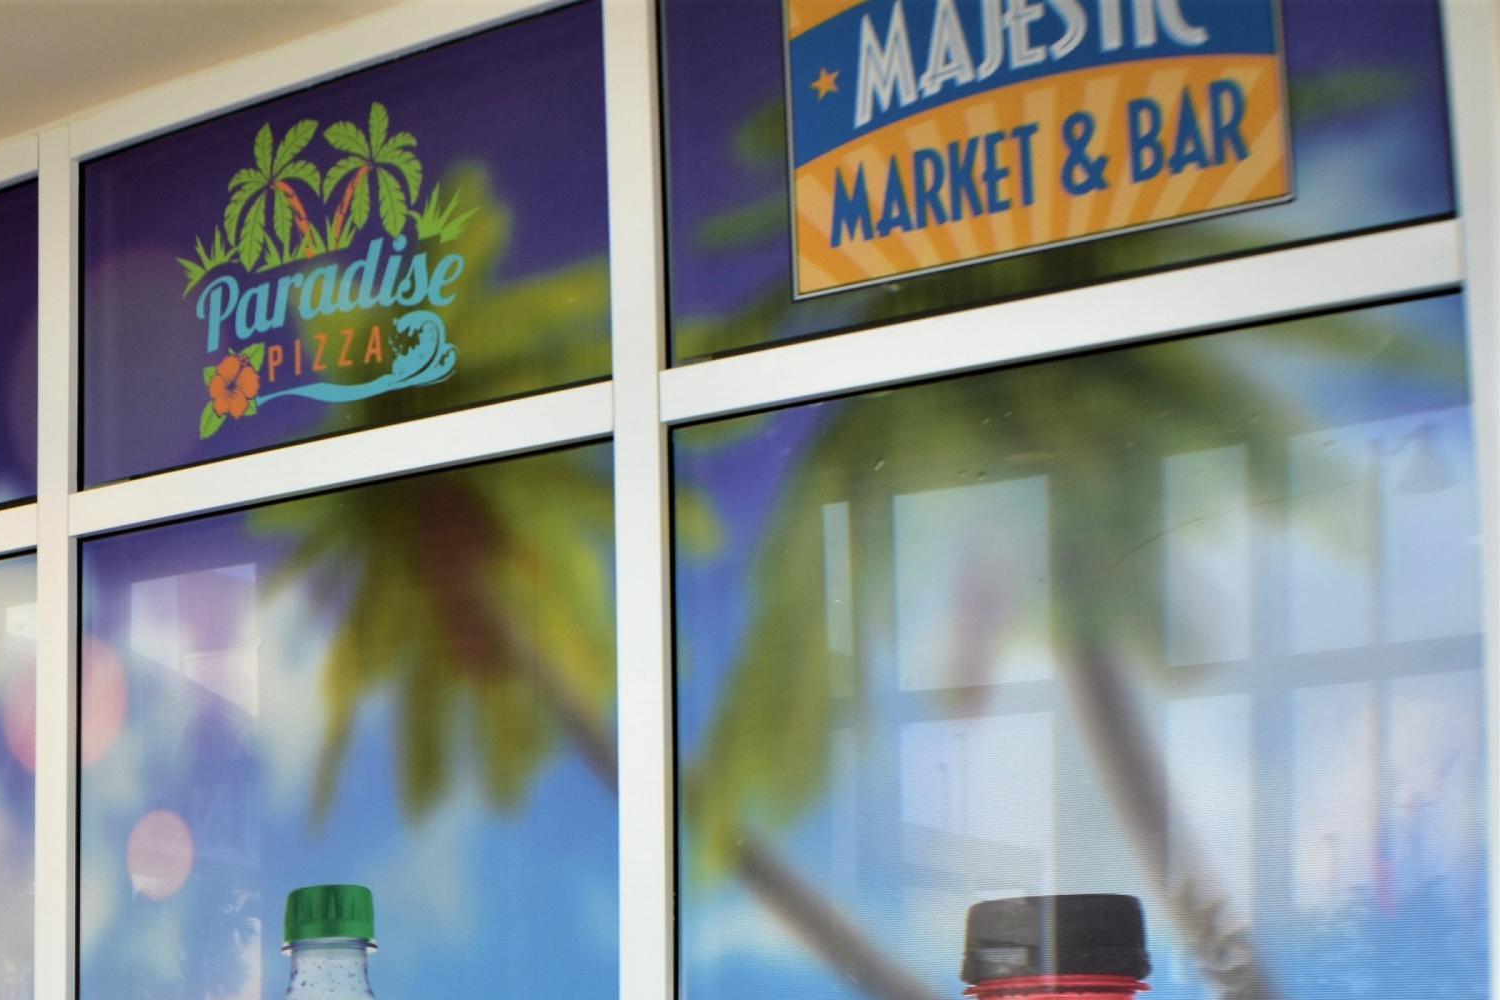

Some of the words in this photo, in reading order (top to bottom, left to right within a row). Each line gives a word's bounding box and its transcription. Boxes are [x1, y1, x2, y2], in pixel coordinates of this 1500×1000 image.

[830, 122, 1039, 249] MARKET
[1061, 111, 1109, 196] &
[1127, 78, 1251, 185] BAR
[196, 234, 465, 353] Paradise
[266, 325, 383, 382] PIZZA
